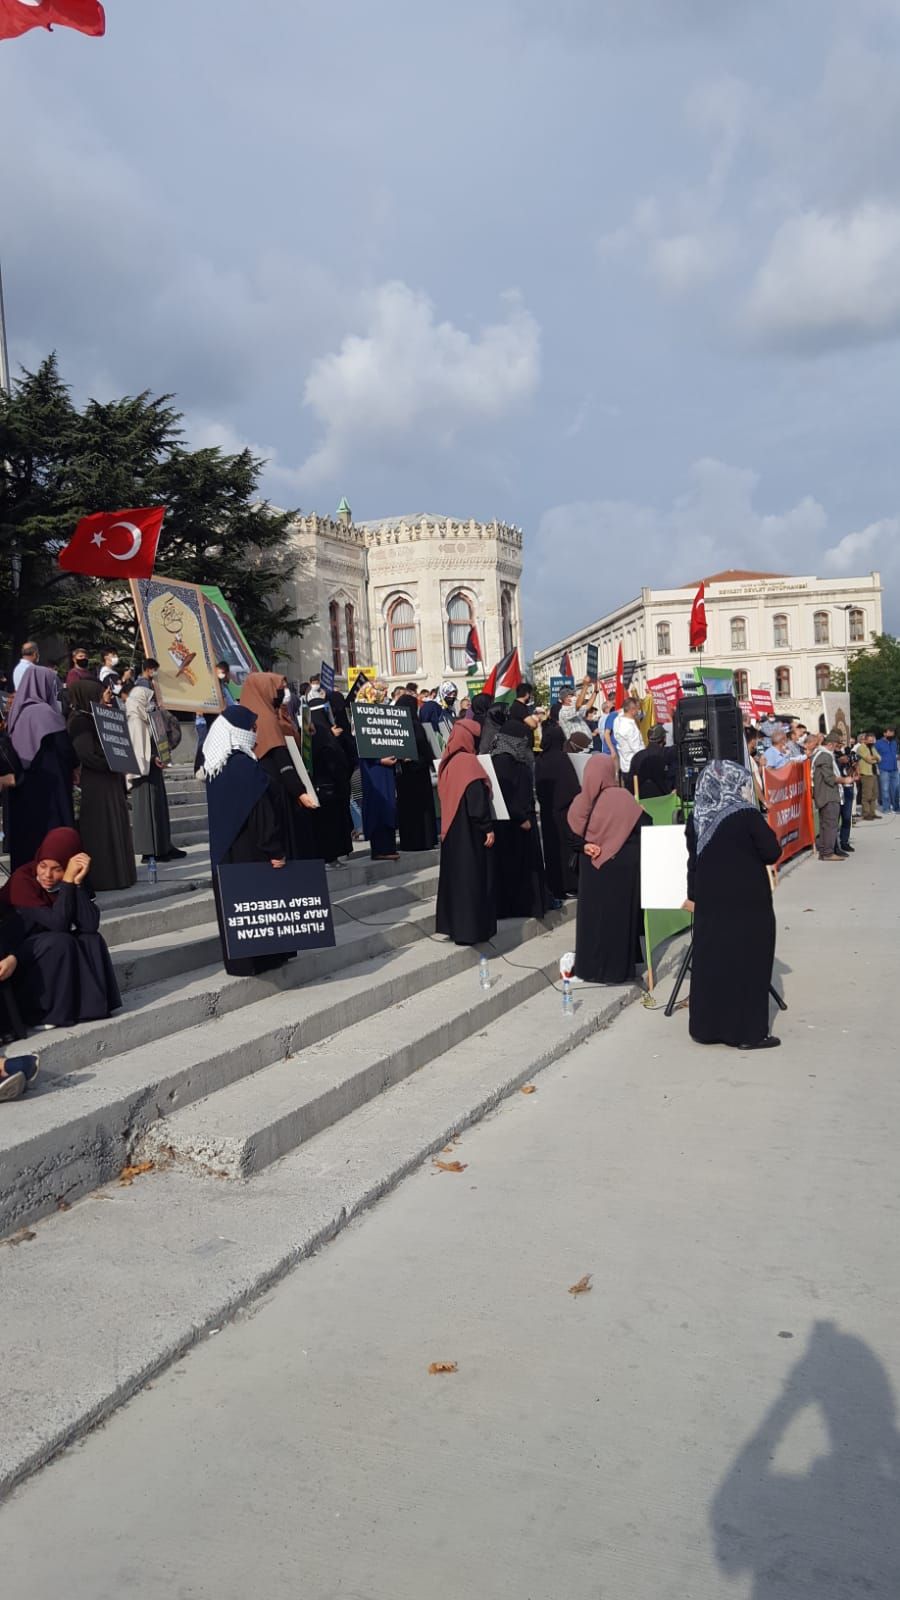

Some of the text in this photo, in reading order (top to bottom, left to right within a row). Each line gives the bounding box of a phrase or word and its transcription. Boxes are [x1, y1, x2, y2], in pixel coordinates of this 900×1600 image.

[356, 705, 407, 717] KUDÜS BİZİM
[366, 717, 402, 728] CANIMIZ,
[361, 727, 409, 737] FEDA OLSUN
[370, 738, 405, 746] KANIMIZ
[233, 896, 322, 913] HESAP VERECEK
[228, 908, 329, 927] ARAP SİYONİSTLER
[237, 927, 274, 939] SATAN
